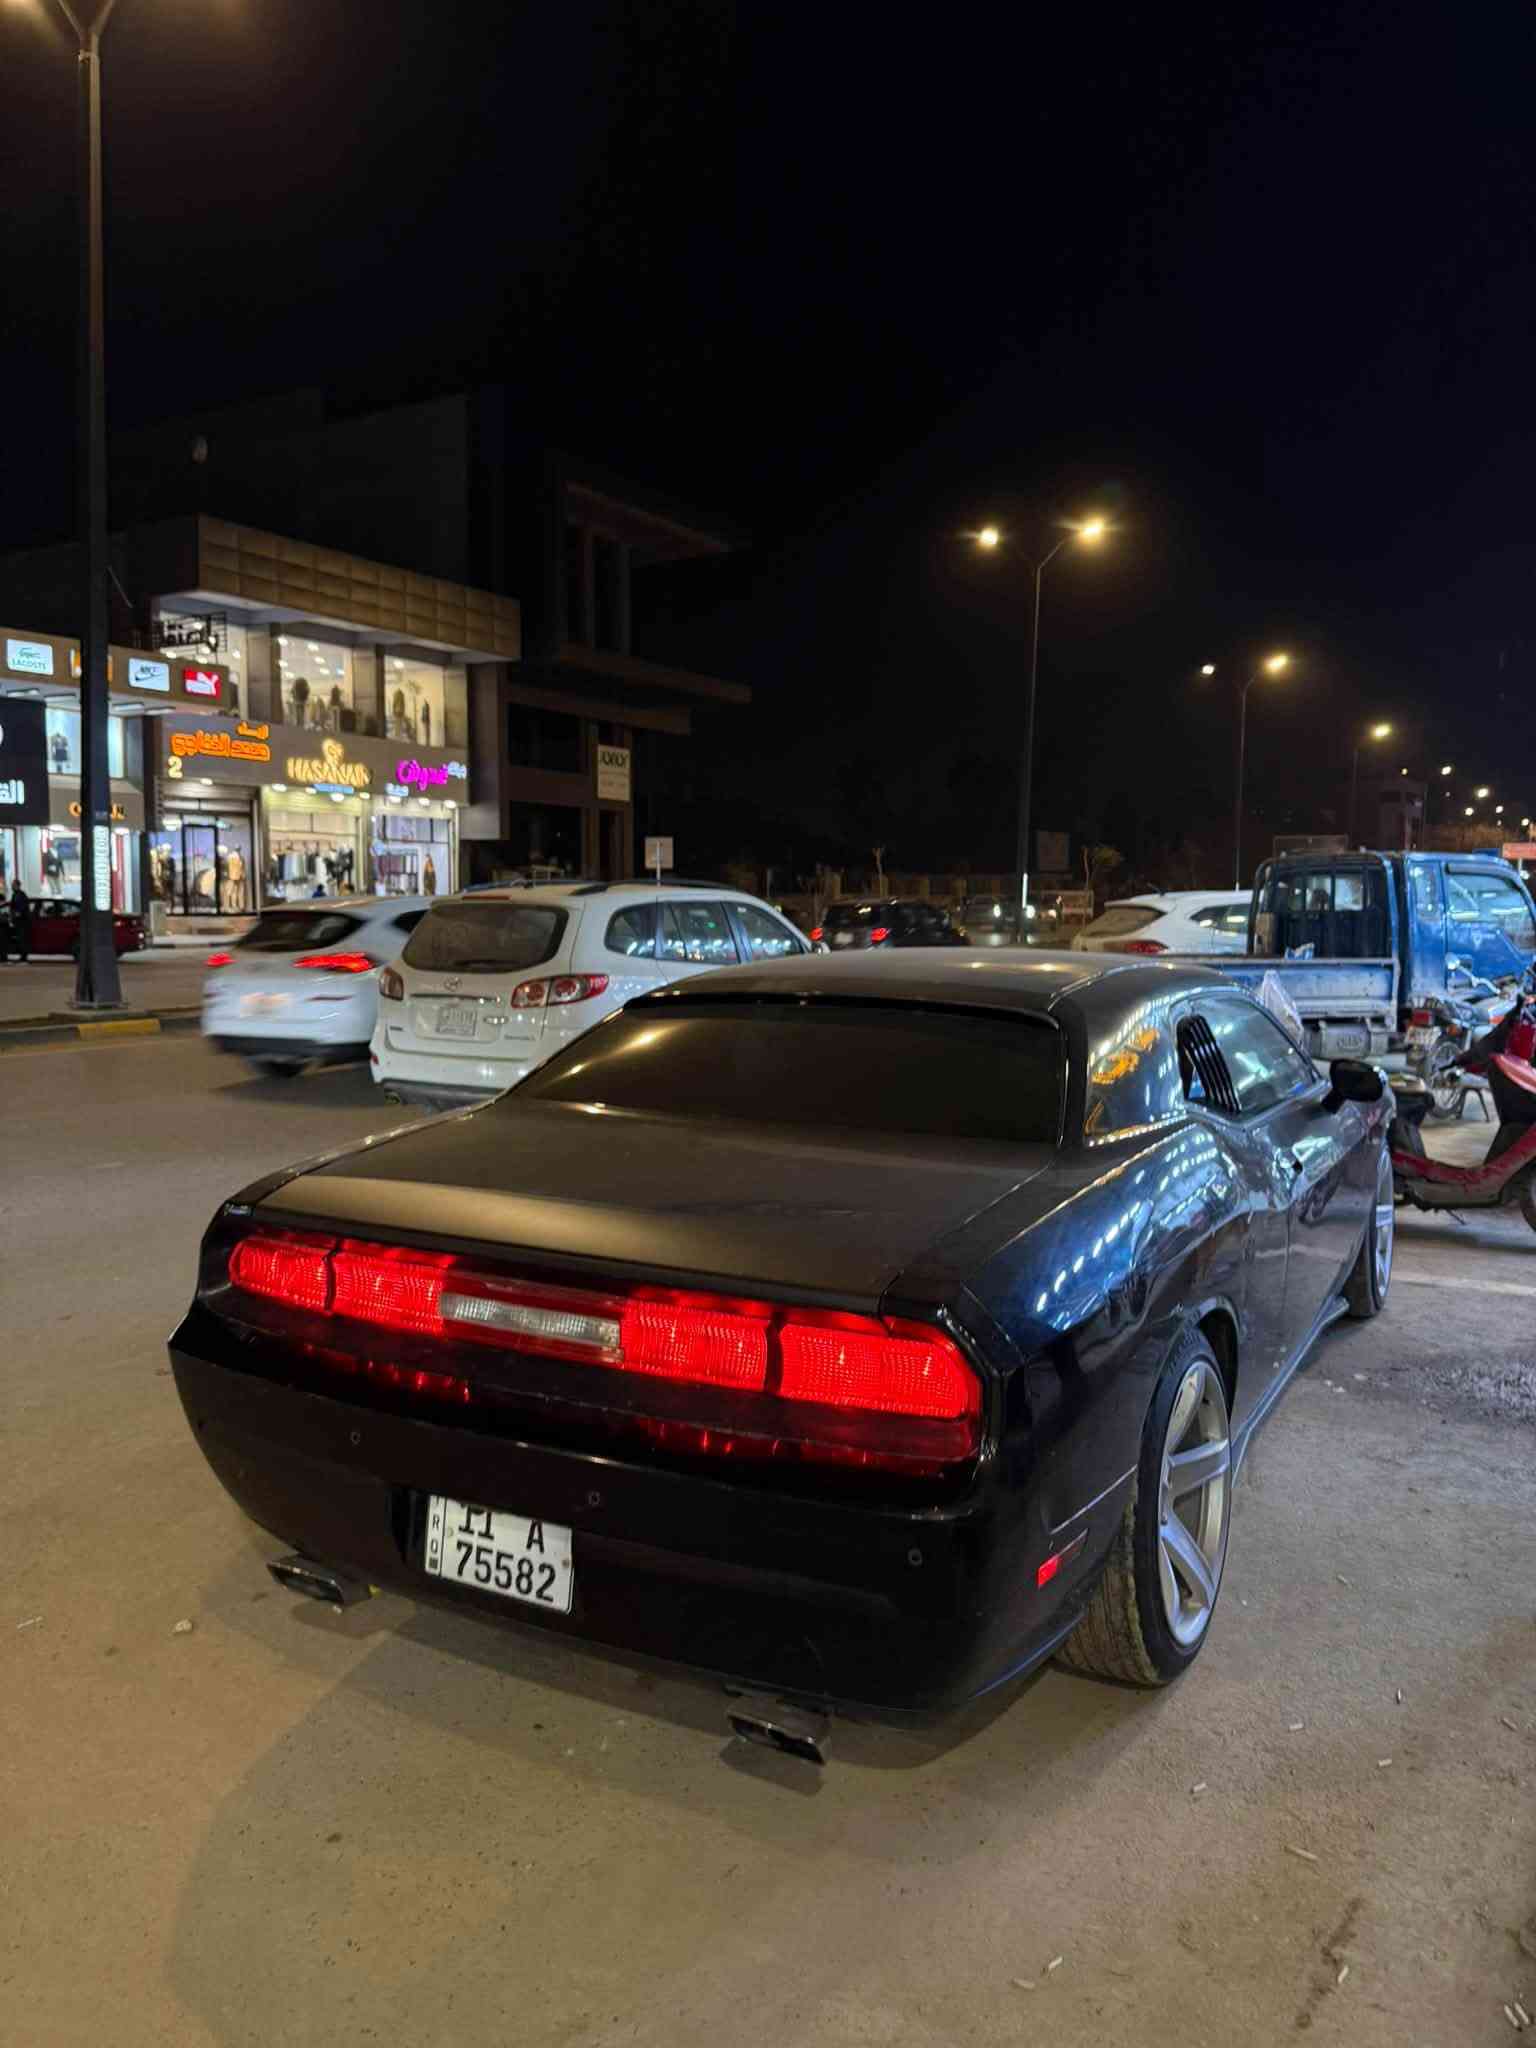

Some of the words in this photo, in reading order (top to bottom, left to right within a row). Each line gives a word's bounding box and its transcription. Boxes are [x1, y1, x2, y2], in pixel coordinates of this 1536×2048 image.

[168, 755, 183, 779] 2
[526, 1519, 545, 1554] A
[455, 1540, 557, 1603] 75582
